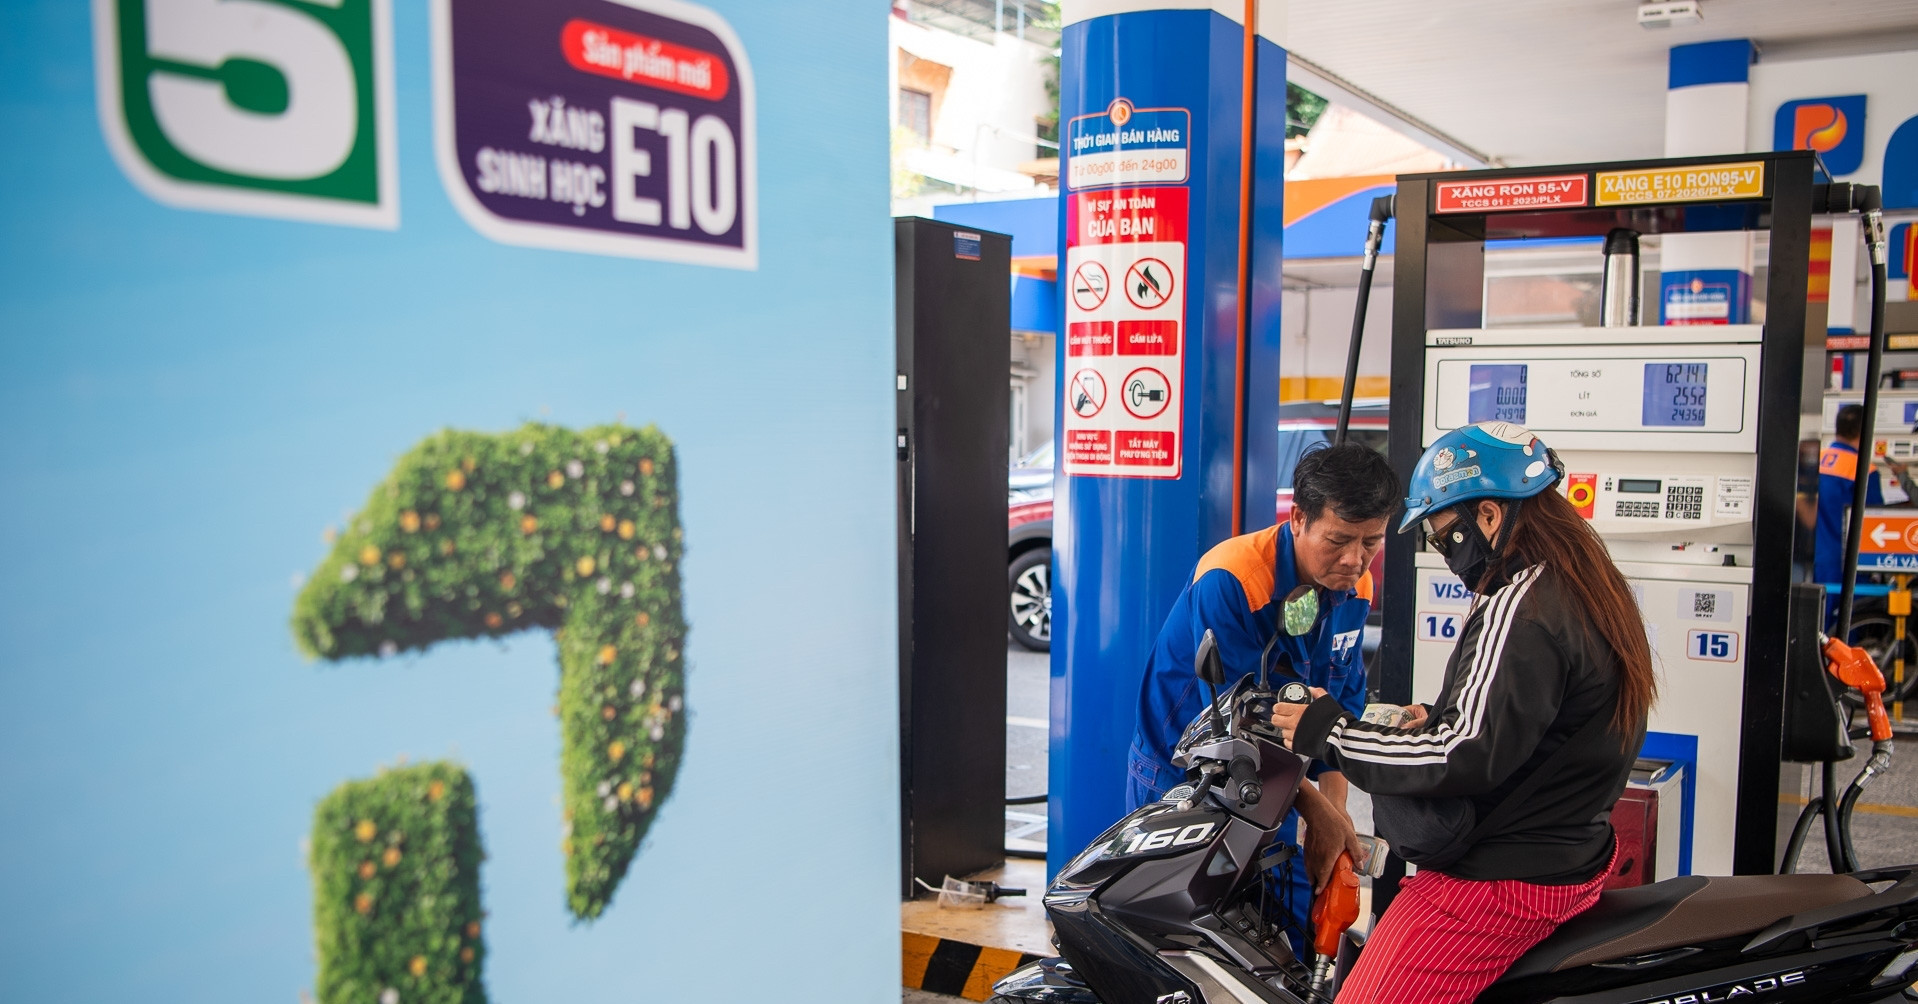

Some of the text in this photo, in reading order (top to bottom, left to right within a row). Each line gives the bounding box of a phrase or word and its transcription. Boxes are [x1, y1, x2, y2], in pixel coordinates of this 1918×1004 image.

[581, 30, 712, 90] Sản phẩm mới
[528, 95, 605, 153] XĂNG
[1073, 127, 1180, 150] THỜI GIAN BÁN HÀNG
[610, 96, 737, 236] E10
[1087, 162, 1115, 176] 00g00
[1119, 159, 1138, 172] đến
[1142, 159, 1177, 173] 24g00
[476, 147, 606, 217] SINH HỌC
[1451, 181, 1572, 198] XĂNG RON 95-V
[1604, 170, 1755, 193] XĂNG E10 RON95-V
[1087, 195, 1156, 213] VÌ SỰ AN TOÀN
[1461, 199, 1489, 208] TCCS
[1492, 198, 1503, 206] 01
[1513, 195, 1561, 206] 2023/PLX
[1619, 190, 1653, 201] TCCS
[1087, 213, 1154, 239] CỦA BẠN
[1129, 333, 1163, 344] CẤM LỬA
[1520, 365, 1527, 384] 0
[1666, 364, 1707, 383] 62141
[1578, 390, 1590, 400] LÍT
[1495, 408, 1525, 420] 24970
[1672, 409, 1705, 421] 24350
[1128, 437, 1159, 449] TẤT MÁY
[1119, 449, 1168, 460] PHƯƠNG TIỆN
[1434, 467, 1480, 488] Doraemon
[1877, 553, 1898, 568] LỐI
[1431, 583, 1474, 599] VISA
[1426, 616, 1456, 638] 16
[1696, 633, 1729, 658] 15
[1125, 822, 1215, 854] 160
[1648, 971, 1806, 1004] BLADE
